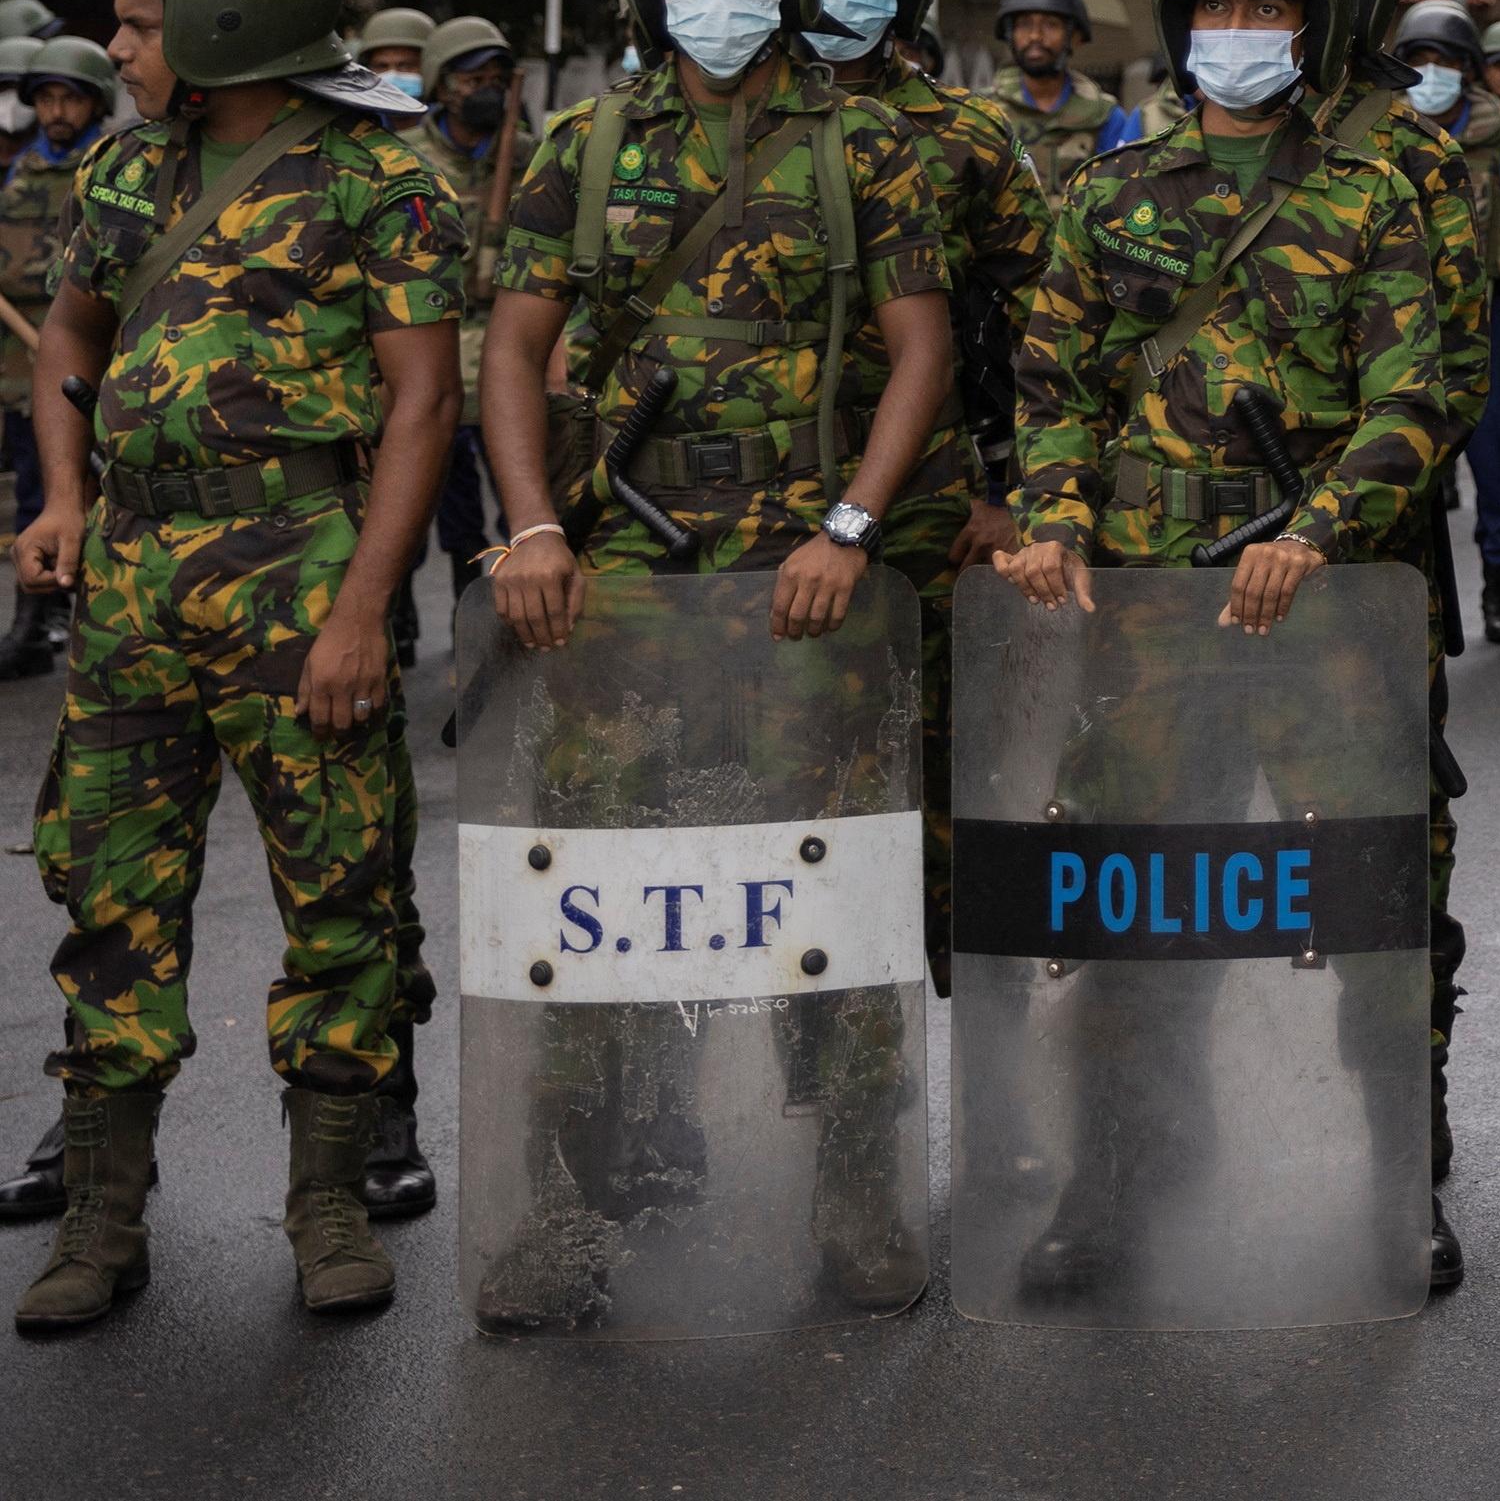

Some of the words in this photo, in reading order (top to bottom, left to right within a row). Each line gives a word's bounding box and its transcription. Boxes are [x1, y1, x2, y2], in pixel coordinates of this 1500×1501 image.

[614, 188, 638, 201] TASK
[640, 189, 678, 205] FORCE
[1092, 223, 1121, 250] SPECIAL
[1124, 242, 1153, 262] TASK
[1154, 253, 1190, 276] FORCE
[559, 879, 794, 954] S.T.F
[1051, 849, 1311, 933] POLICE
